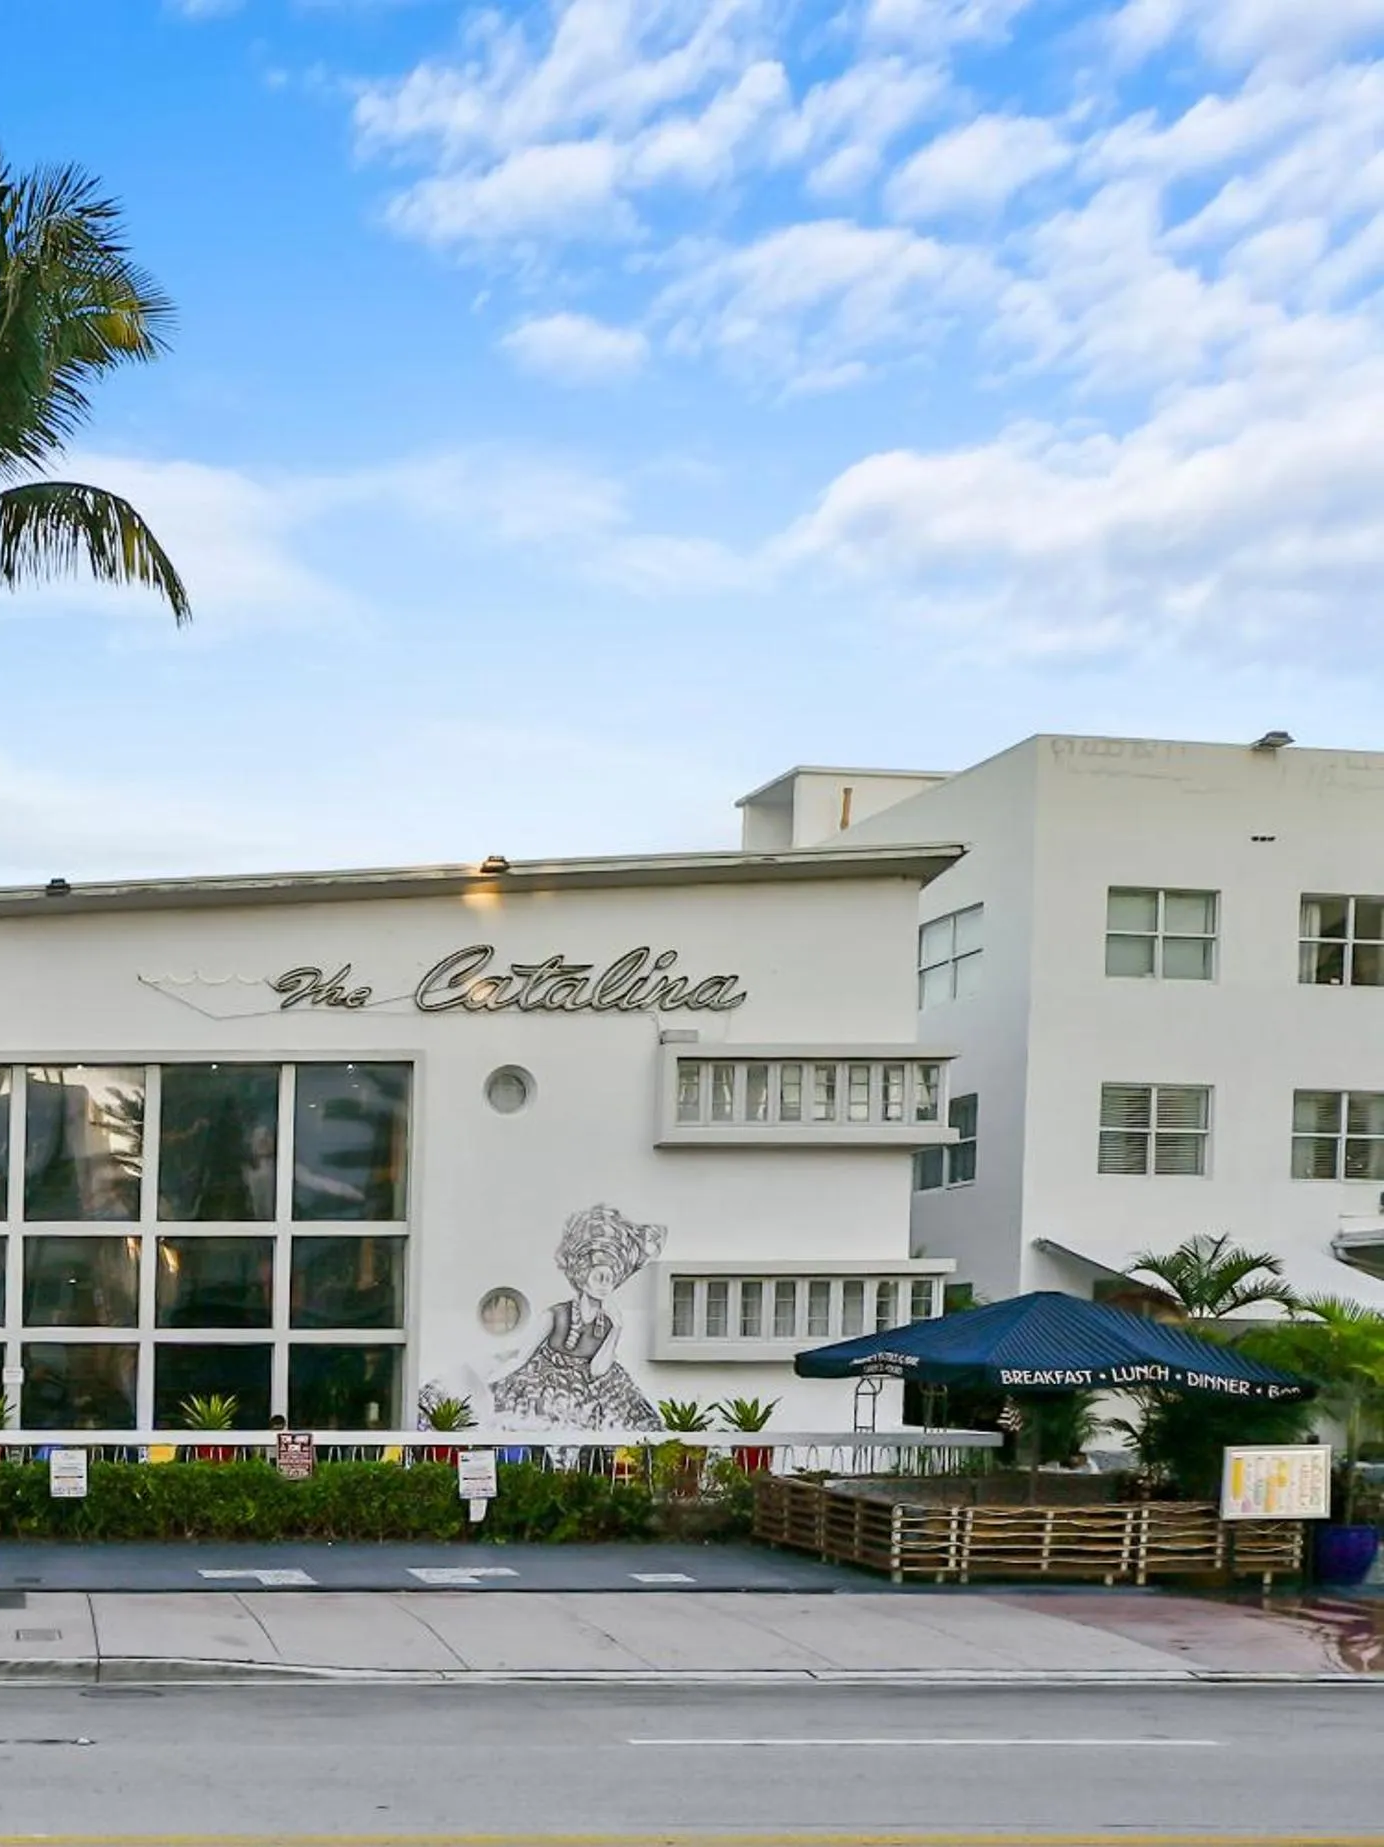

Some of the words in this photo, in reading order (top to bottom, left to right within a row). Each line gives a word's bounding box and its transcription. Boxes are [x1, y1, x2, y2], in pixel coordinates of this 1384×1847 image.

[271, 963, 371, 1009] The
[415, 944, 747, 1012] Catalina
[1000, 1369, 1093, 1385] BREAKFAST
[1111, 1364, 1170, 1383] LUNCH
[1186, 1372, 1251, 1396] DINNER
